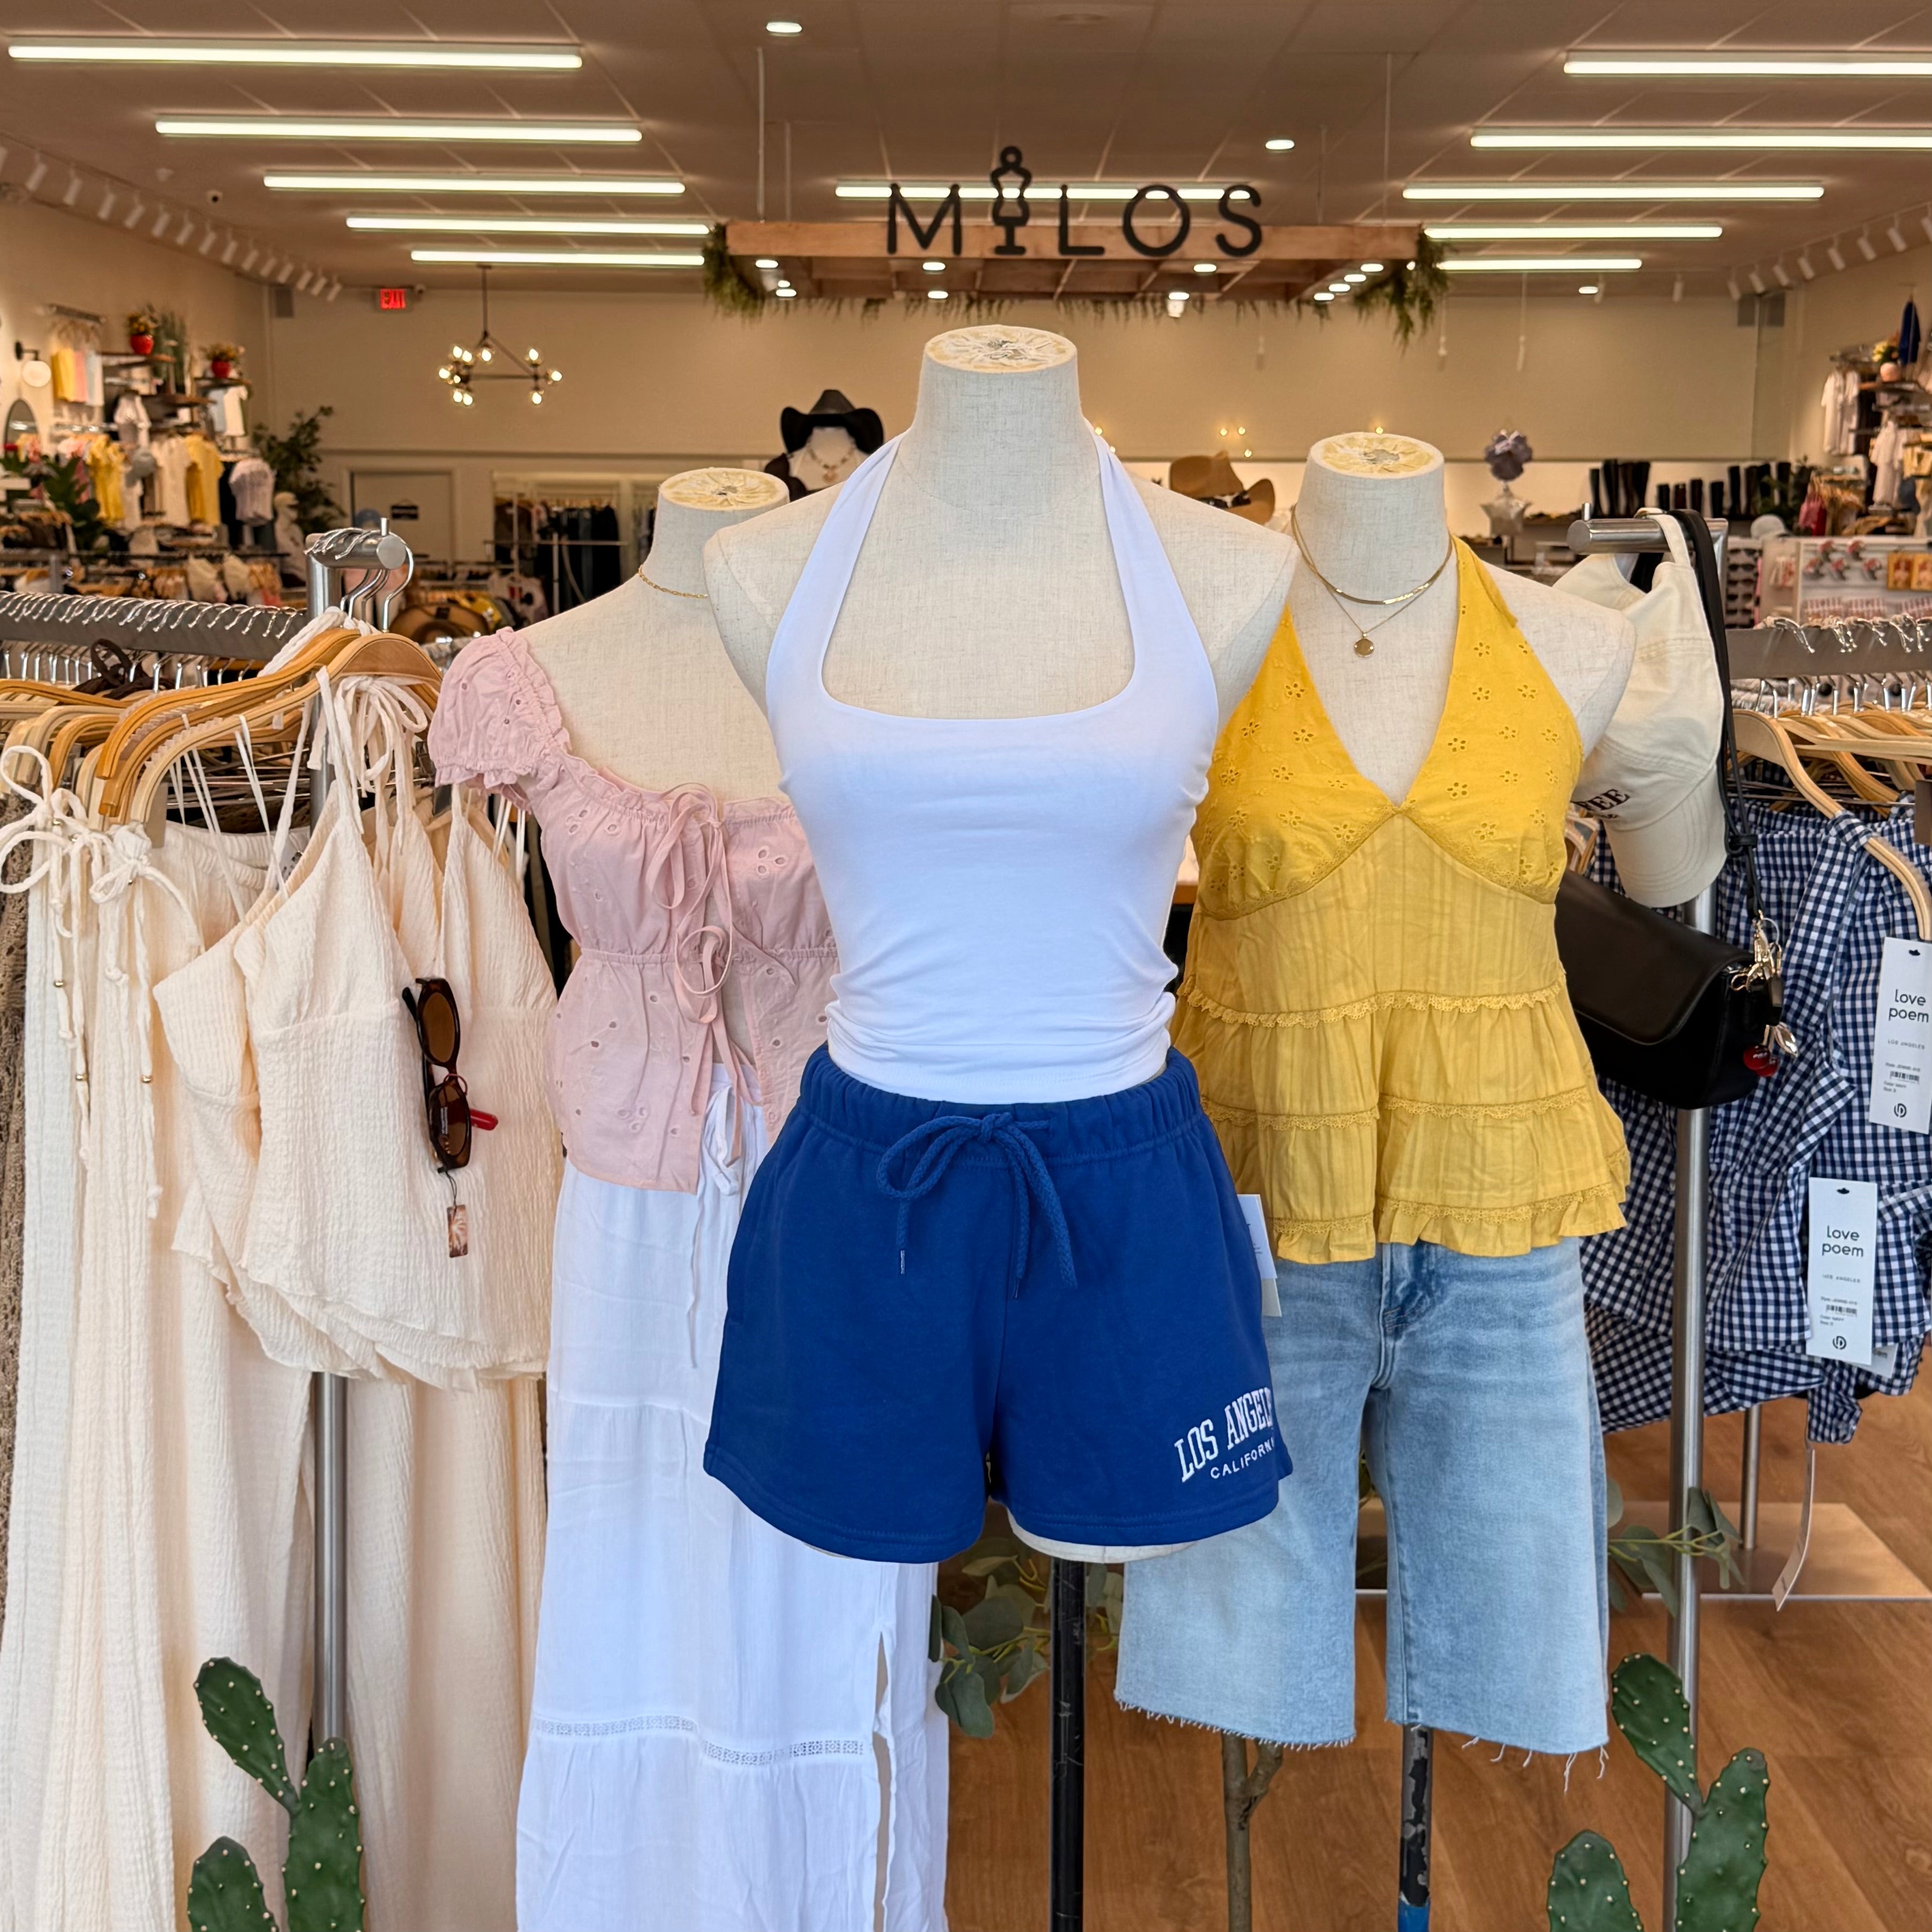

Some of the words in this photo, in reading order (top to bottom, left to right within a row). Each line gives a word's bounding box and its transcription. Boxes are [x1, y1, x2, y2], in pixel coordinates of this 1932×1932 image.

[887, 146, 1262, 256] MILOS
[1888, 1007, 1929, 1023] poem
[1822, 1243, 1864, 1257] poem
[1174, 1419, 1219, 1483] LOS
